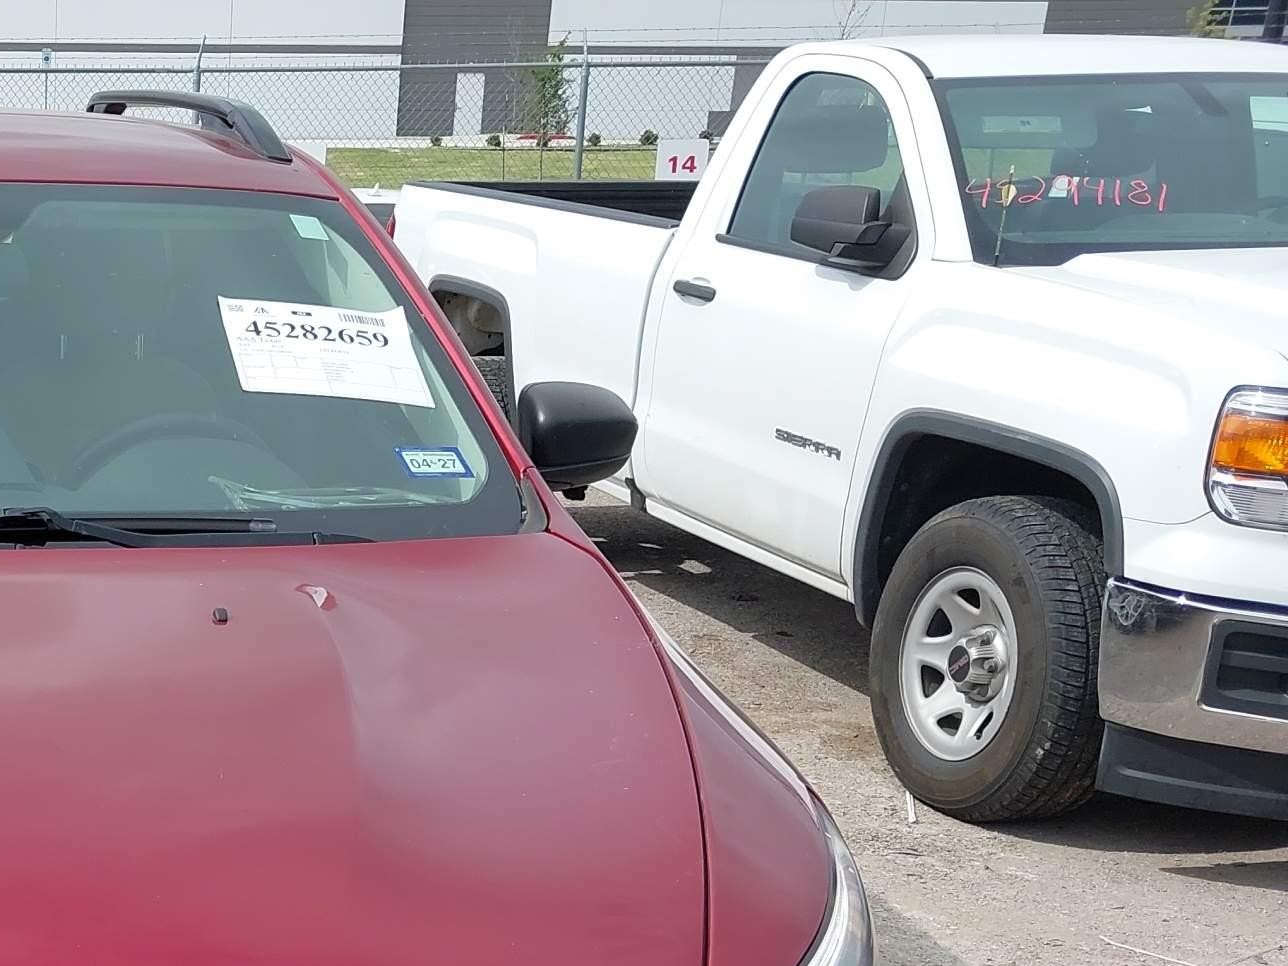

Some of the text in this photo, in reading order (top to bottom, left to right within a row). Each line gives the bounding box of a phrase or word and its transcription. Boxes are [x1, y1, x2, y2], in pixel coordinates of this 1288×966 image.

[668, 155, 697, 174] 14
[245, 320, 390, 349] 45282659
[775, 427, 841, 461] SIERRA
